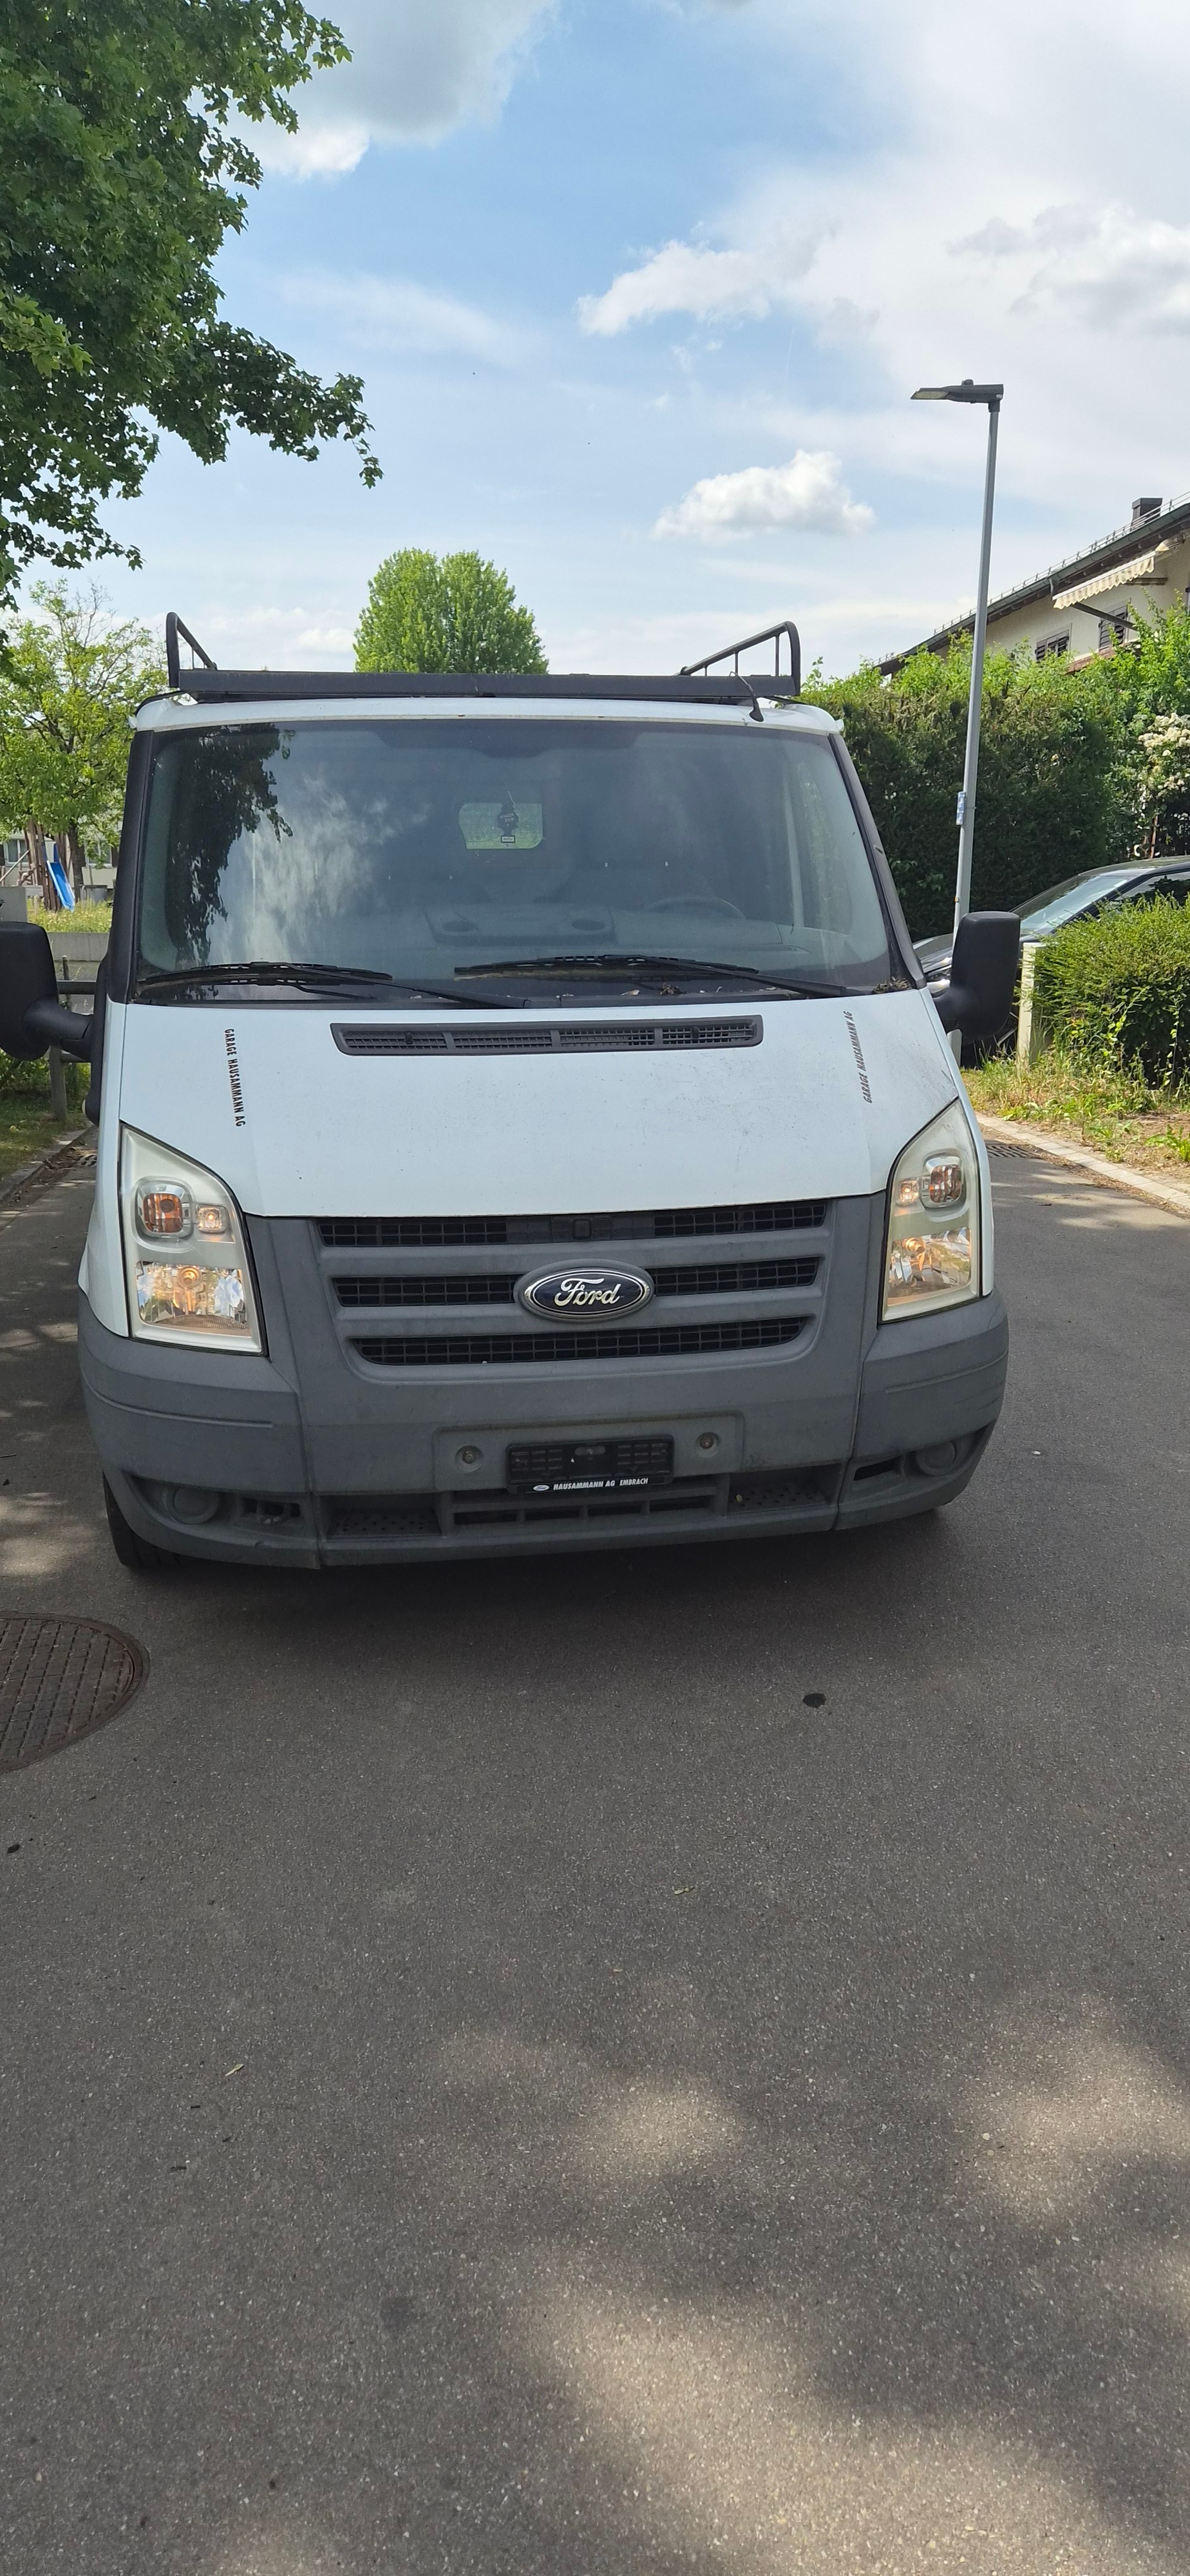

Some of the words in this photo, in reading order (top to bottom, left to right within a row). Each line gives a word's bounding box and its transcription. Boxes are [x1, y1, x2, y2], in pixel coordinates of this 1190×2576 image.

[843, 1010, 854, 1021] AG
[225, 1028, 237, 1056] GARAGE
[846, 1021, 866, 1072] HAUSAMMANN
[228, 1058, 244, 1113] HAUSAMMANN
[858, 1072, 873, 1103] GARAGE
[235, 1115, 246, 1127] AG
[554, 1278, 622, 1307] Ford
[553, 1481, 604, 1491] HAUSAMMANN
[619, 1478, 648, 1486] EMBRACH
